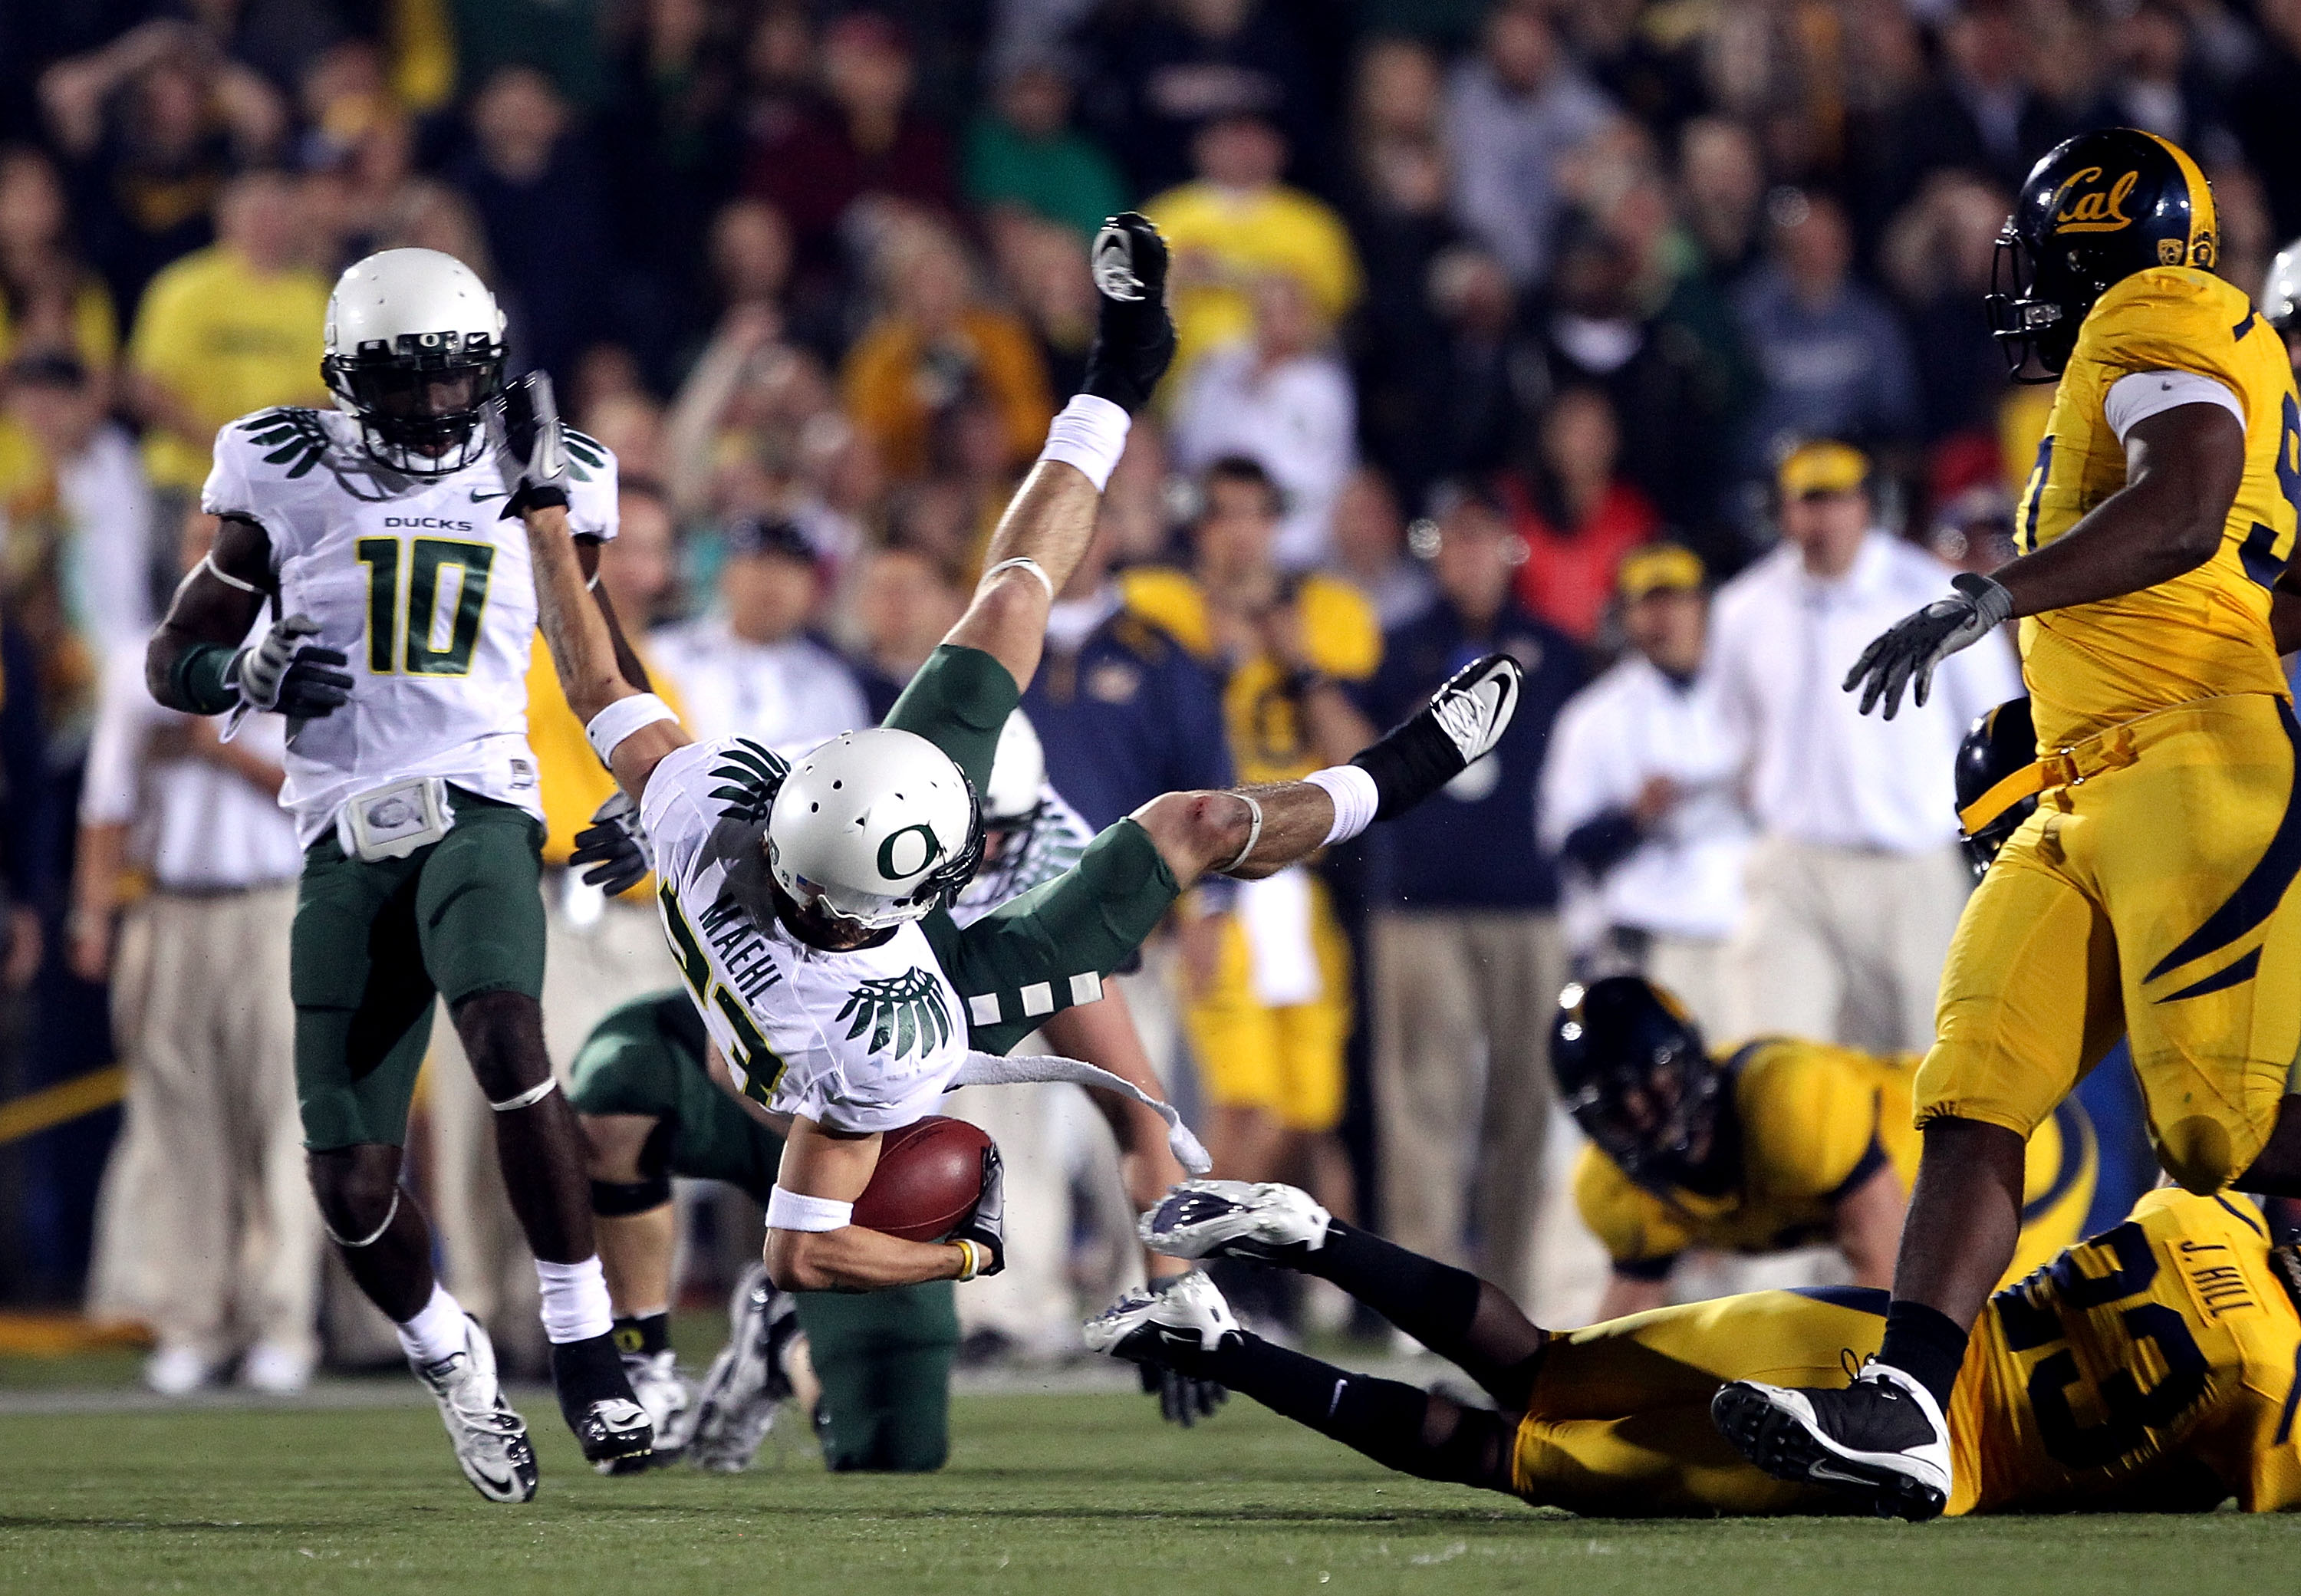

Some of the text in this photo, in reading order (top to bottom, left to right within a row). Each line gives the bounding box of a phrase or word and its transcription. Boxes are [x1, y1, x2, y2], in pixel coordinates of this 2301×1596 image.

[2052, 166, 2138, 235] Cal
[384, 517, 473, 531] DUCKS
[354, 535, 496, 678] 10
[877, 824, 942, 880] O
[698, 892, 783, 1007] MAEHL
[2181, 1241, 2254, 1318] J. HILL
